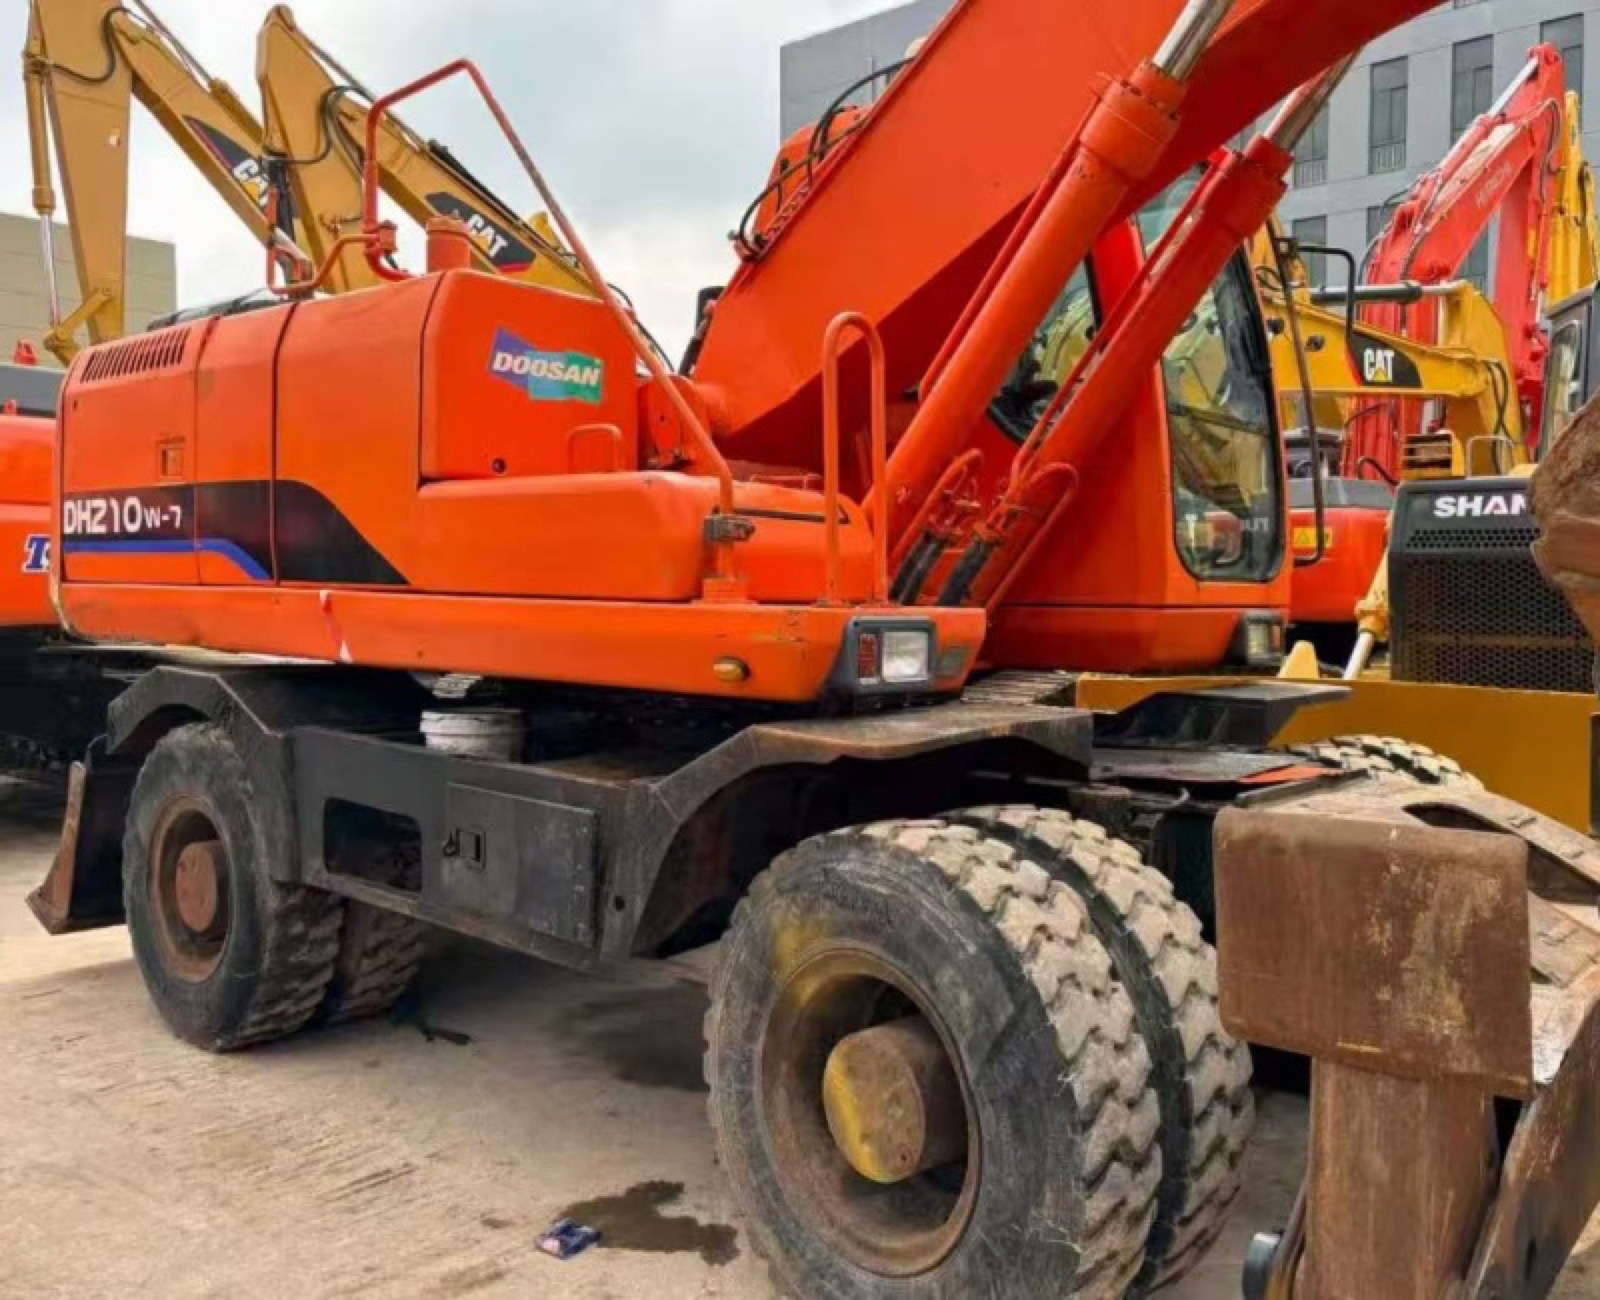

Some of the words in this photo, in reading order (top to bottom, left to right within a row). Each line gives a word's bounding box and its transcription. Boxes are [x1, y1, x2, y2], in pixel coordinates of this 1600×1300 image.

[467, 213, 508, 258] CAT
[491, 351, 601, 387] DOOSAN
[1363, 347, 1395, 383] CAT
